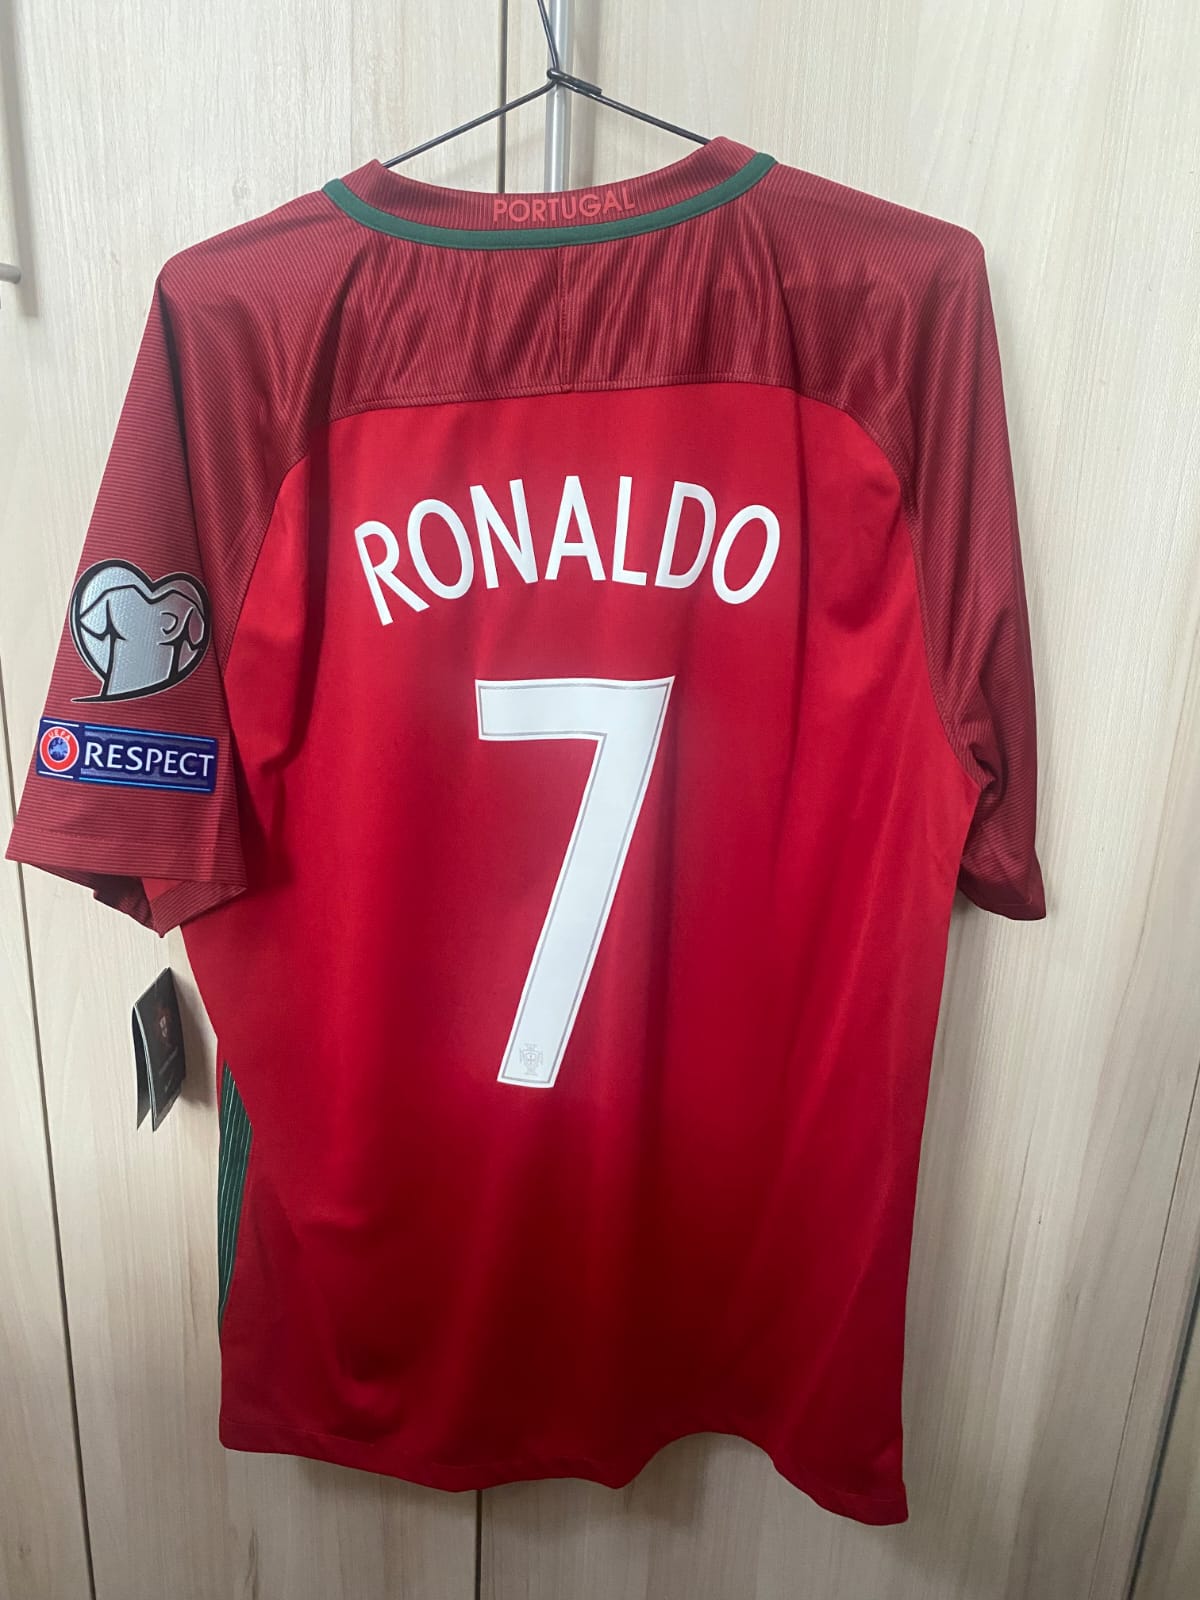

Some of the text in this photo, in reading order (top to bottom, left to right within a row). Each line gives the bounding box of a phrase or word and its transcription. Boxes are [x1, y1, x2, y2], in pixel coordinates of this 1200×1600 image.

[493, 186, 636, 224] PORTUGAL
[354, 475, 781, 626] RONALDO
[48, 729, 71, 741] UEFA
[84, 741, 215, 777] RESPECT
[475, 676, 675, 1089] 7
